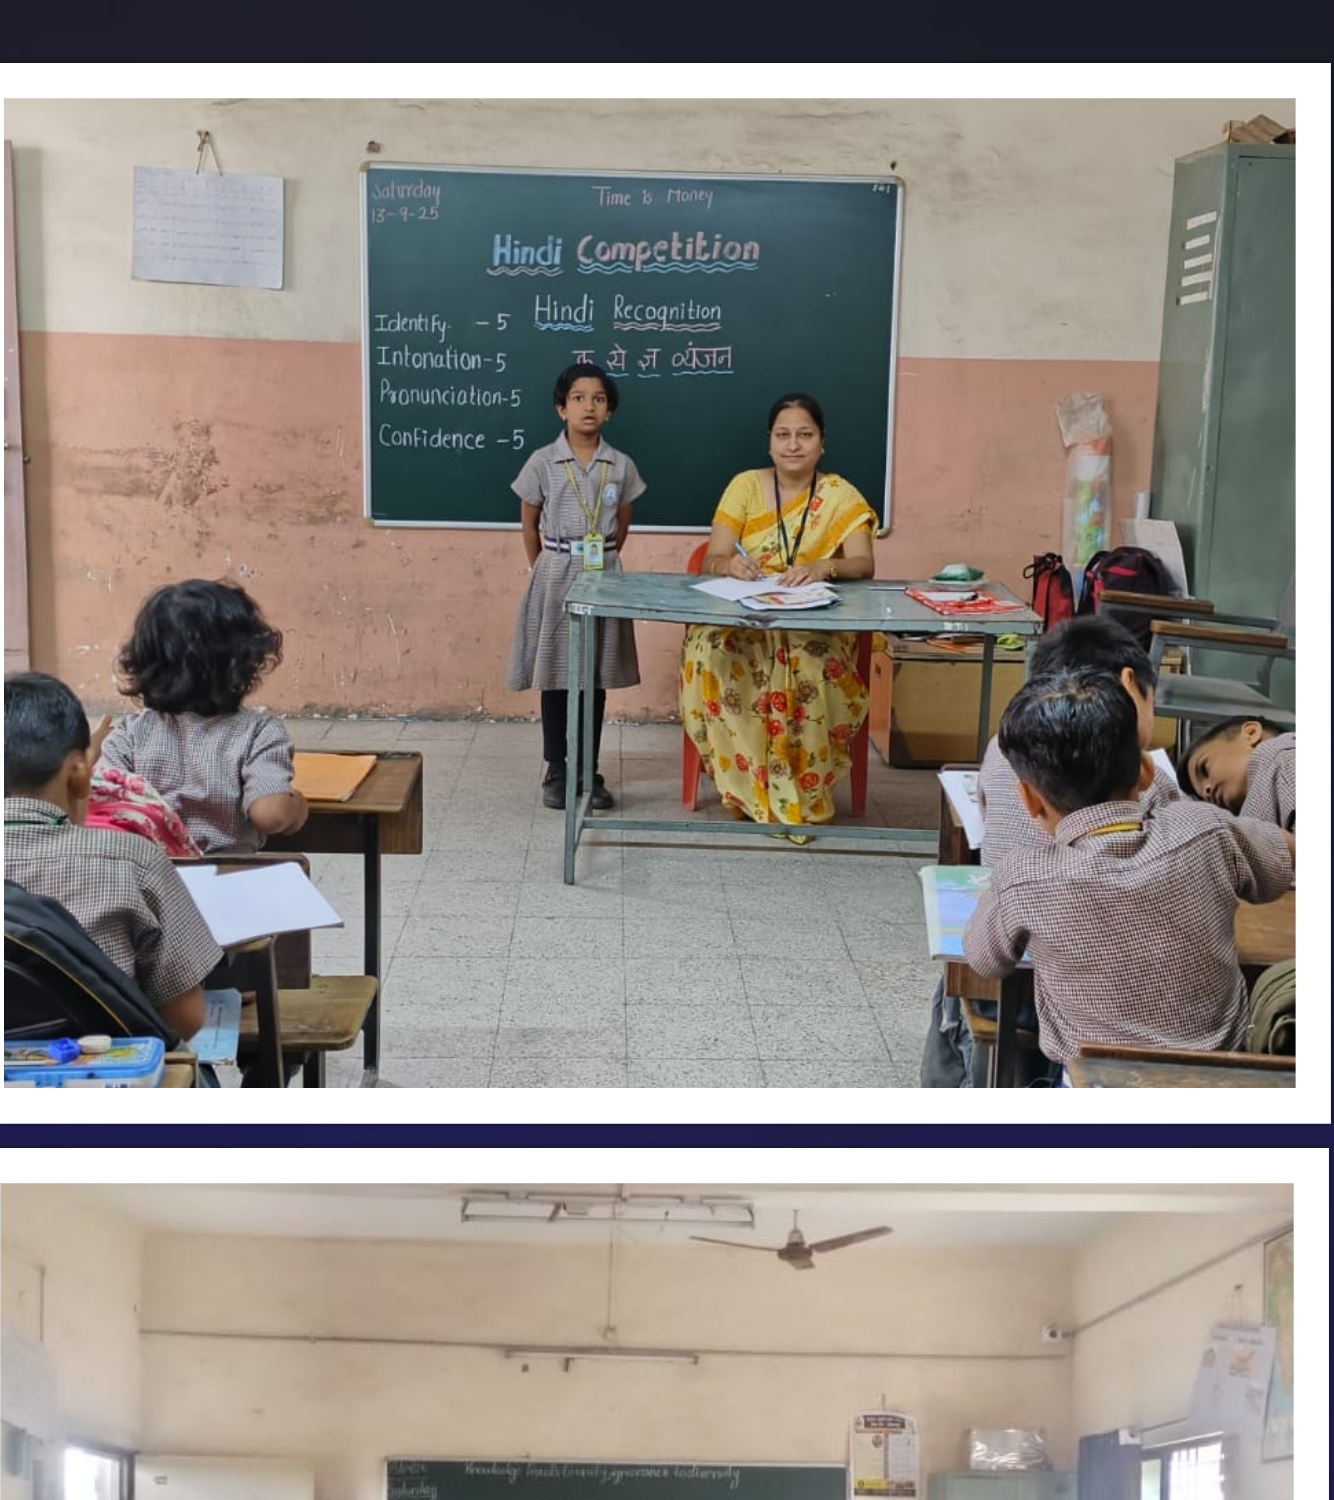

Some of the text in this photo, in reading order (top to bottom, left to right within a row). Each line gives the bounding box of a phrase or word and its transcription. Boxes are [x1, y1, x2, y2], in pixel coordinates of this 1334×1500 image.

[372, 179, 441, 207] Saturday
[592, 185, 631, 208] Time
[667, 186, 714, 208] Money
[371, 206, 439, 223] 13-9-25
[493, 231, 760, 272] Hindi Competition
[535, 295, 721, 327] Hindi Recognition
[606, 342, 628, 371] से
[671, 341, 732, 370] व्यंजन
[379, 422, 485, 449] Confidence
